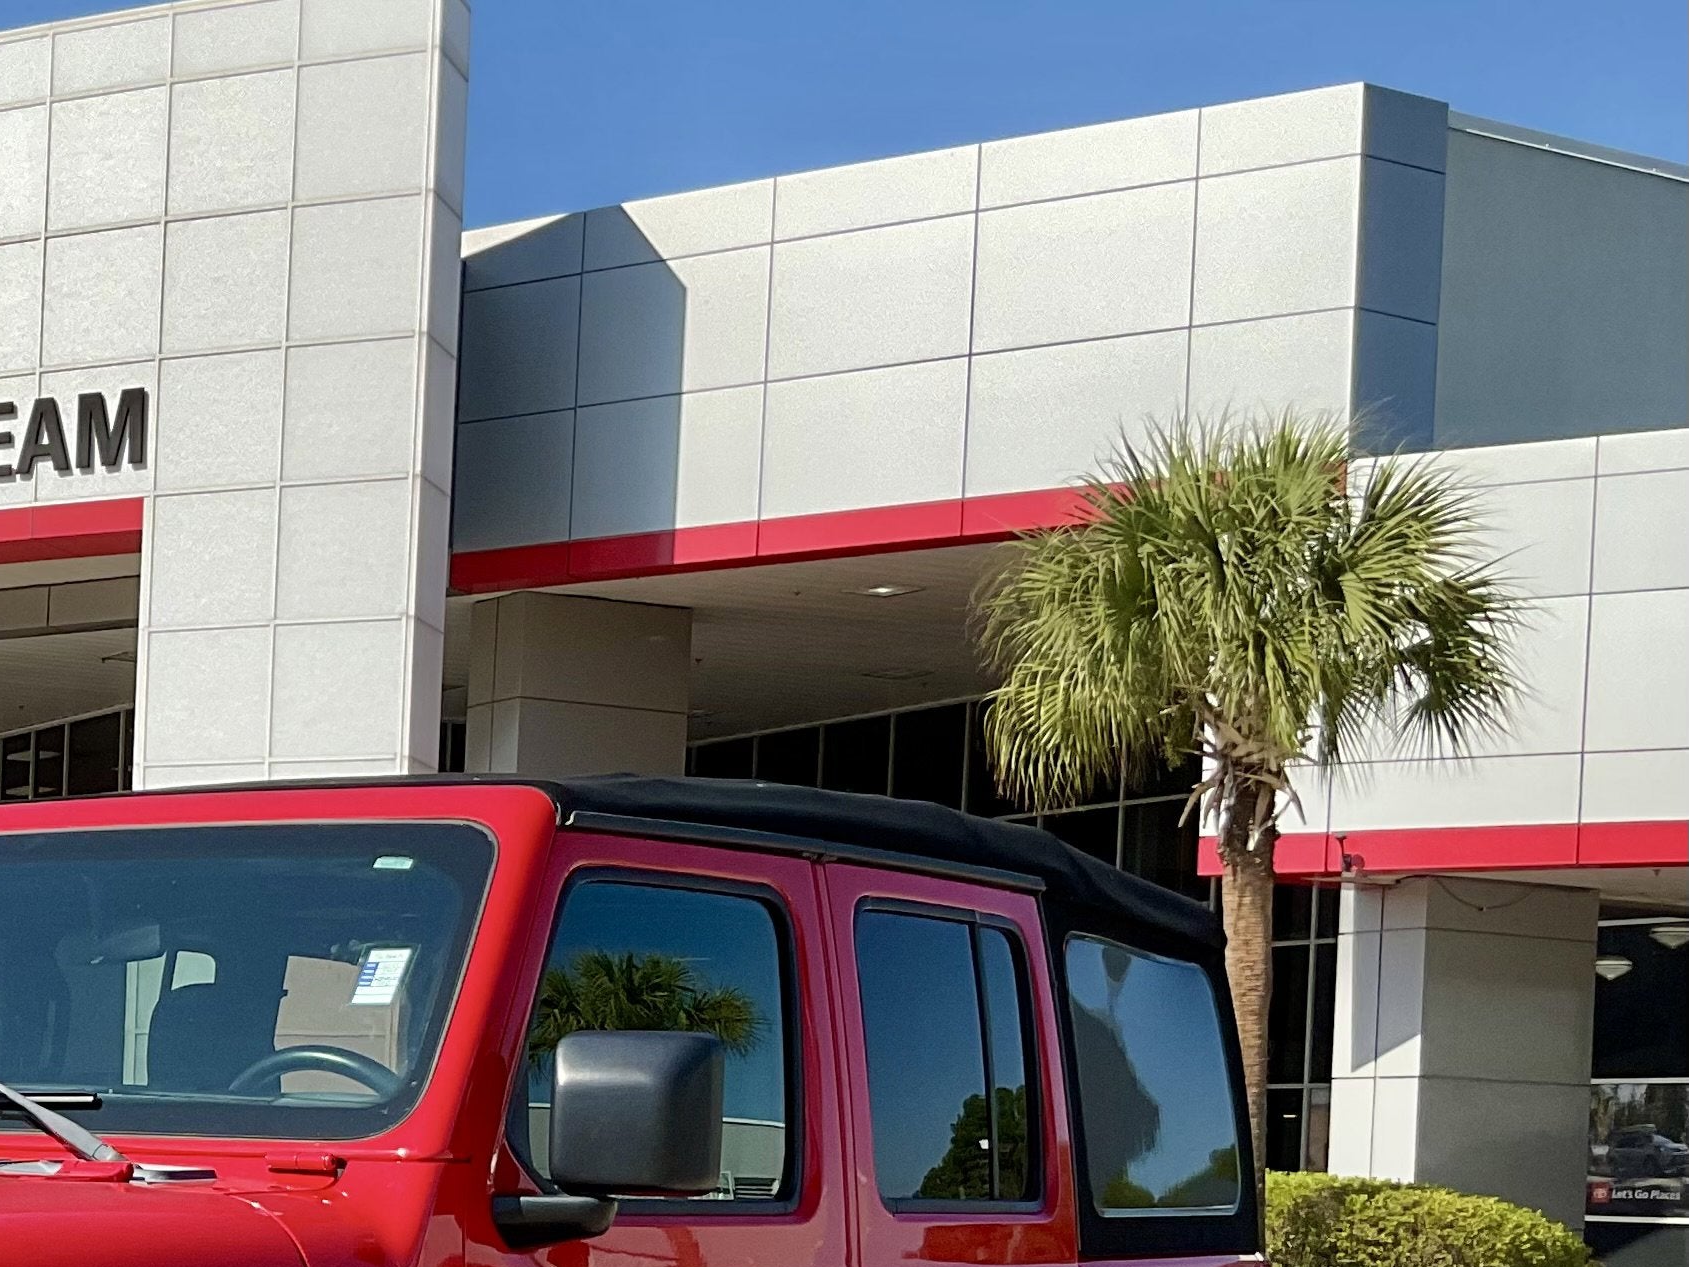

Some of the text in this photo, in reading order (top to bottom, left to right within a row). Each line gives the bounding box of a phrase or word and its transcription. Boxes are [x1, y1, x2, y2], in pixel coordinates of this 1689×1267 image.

[1611, 1187, 1681, 1201] Let's Go Places
